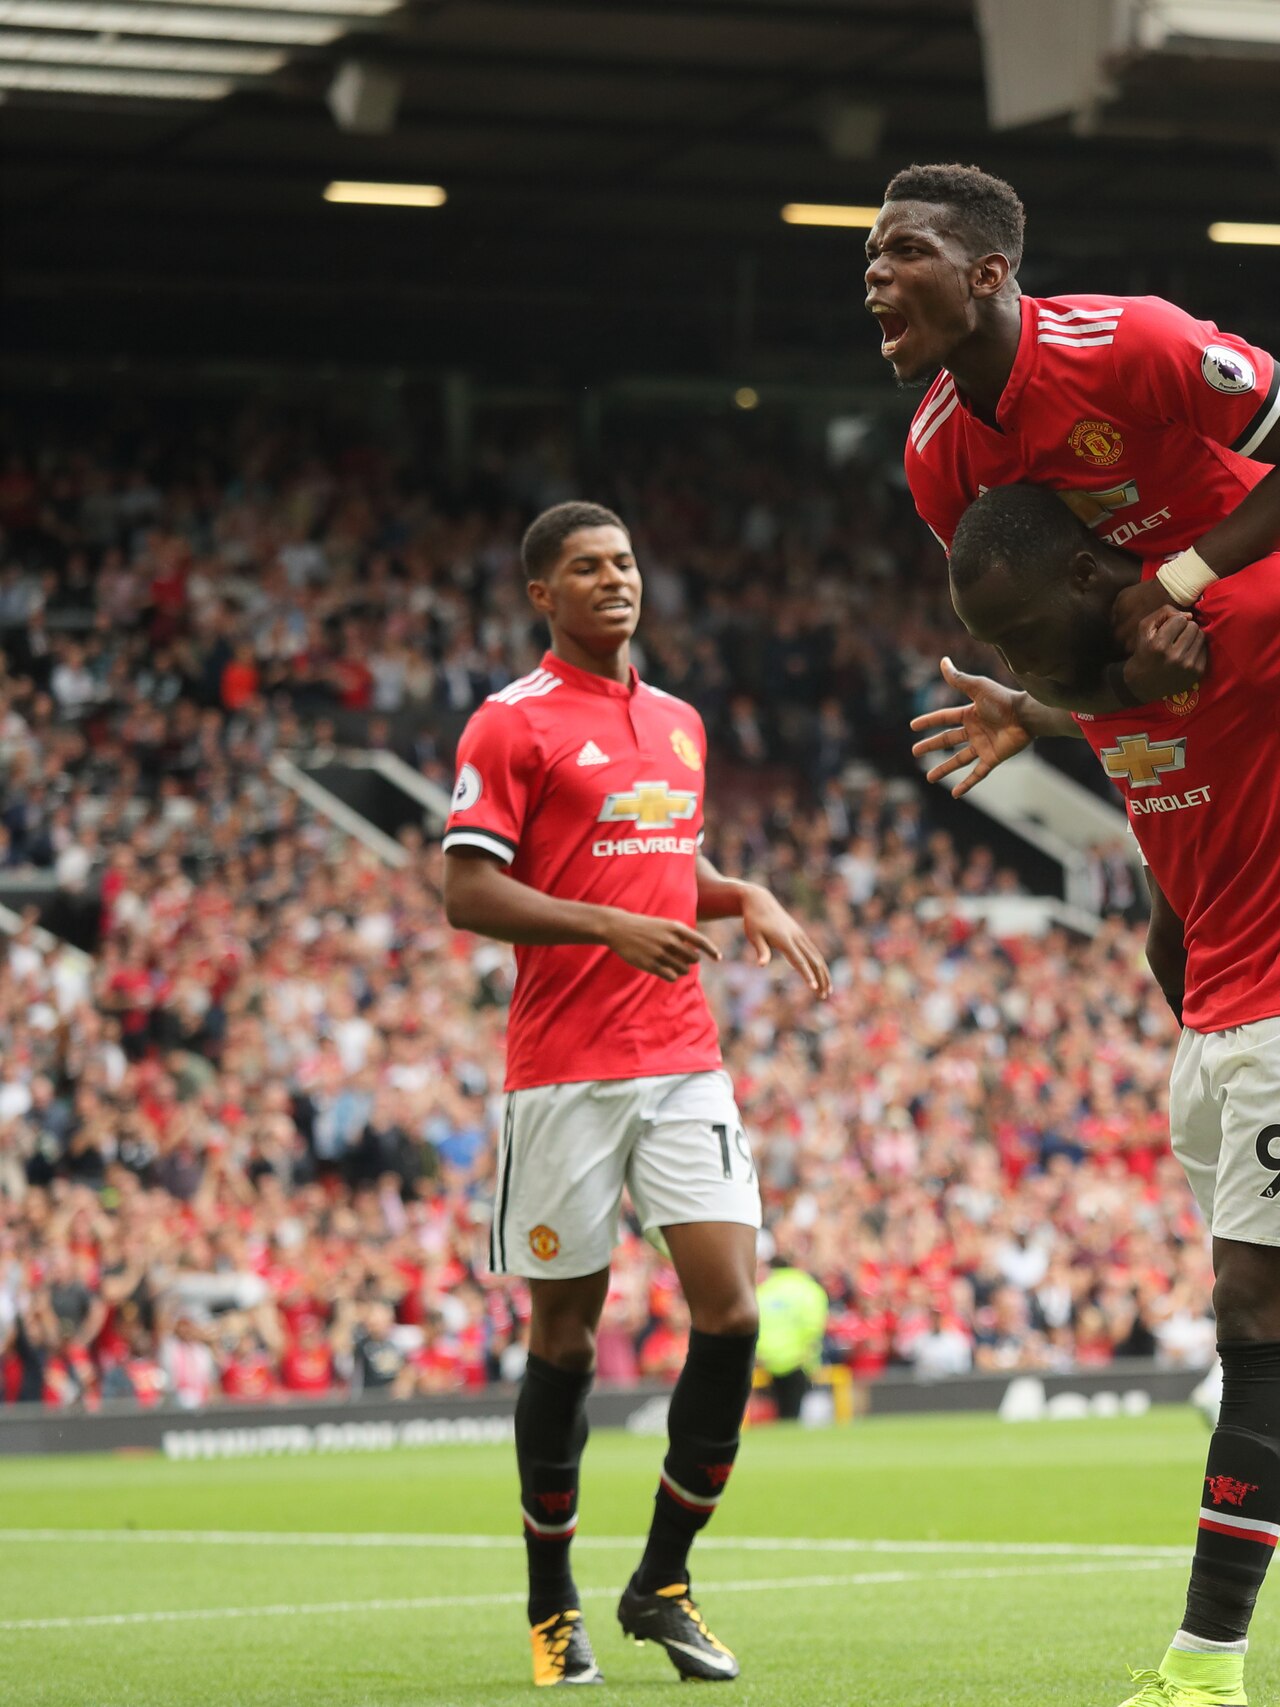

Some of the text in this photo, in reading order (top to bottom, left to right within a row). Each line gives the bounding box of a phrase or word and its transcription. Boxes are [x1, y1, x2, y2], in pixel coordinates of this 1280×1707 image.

[1073, 423, 1110, 446] MANCHESTER
[1094, 448, 1120, 464] UNITED
[1172, 699, 1195, 713] UNITED
